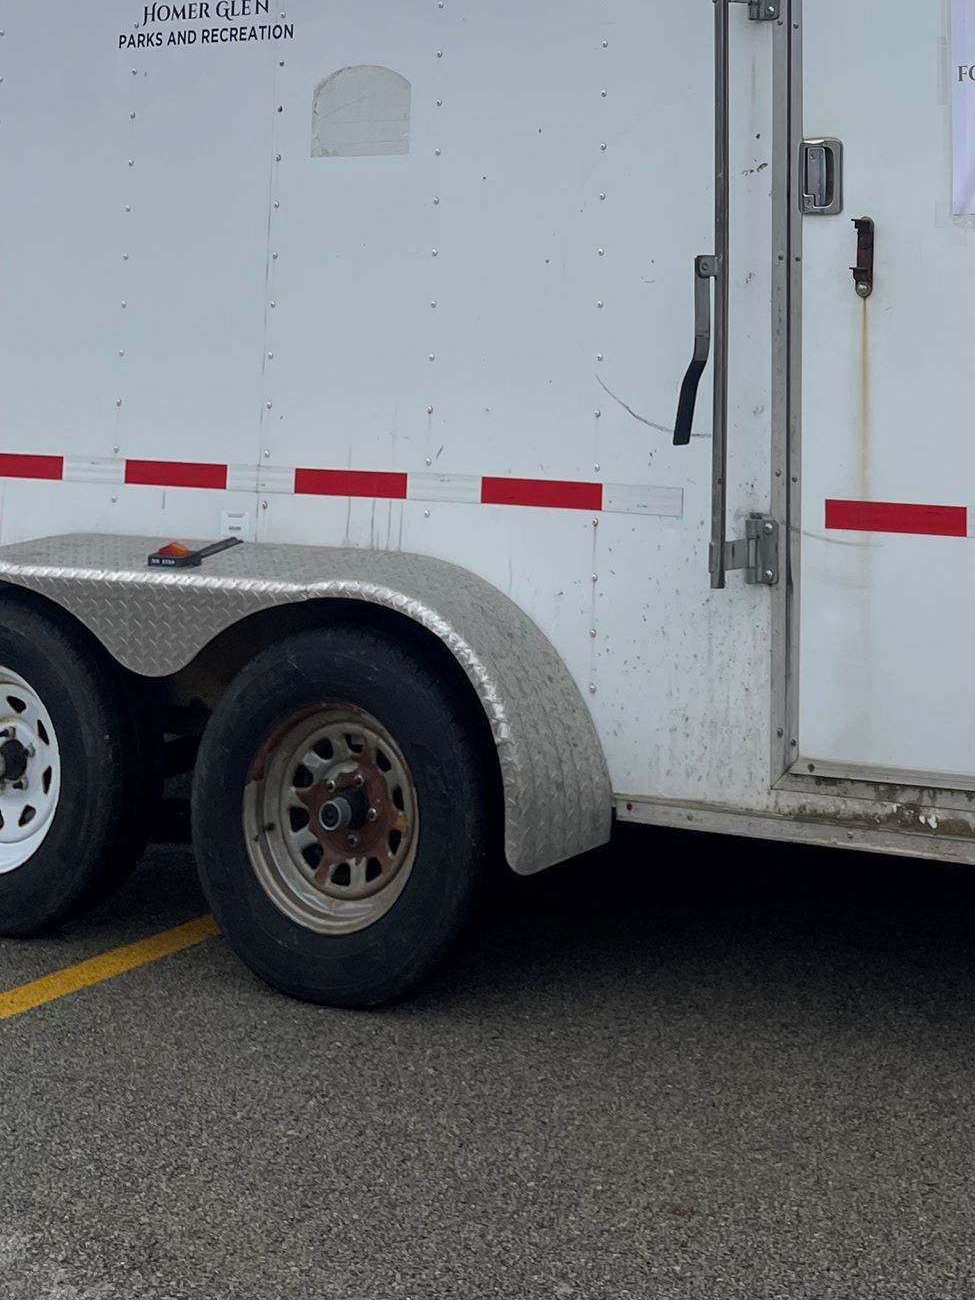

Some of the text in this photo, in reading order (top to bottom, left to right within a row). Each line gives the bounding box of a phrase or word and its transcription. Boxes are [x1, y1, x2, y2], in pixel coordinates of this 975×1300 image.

[142, 2, 211, 27] HOMER
[118, 24, 294, 49] PARKS AND RECREATION
